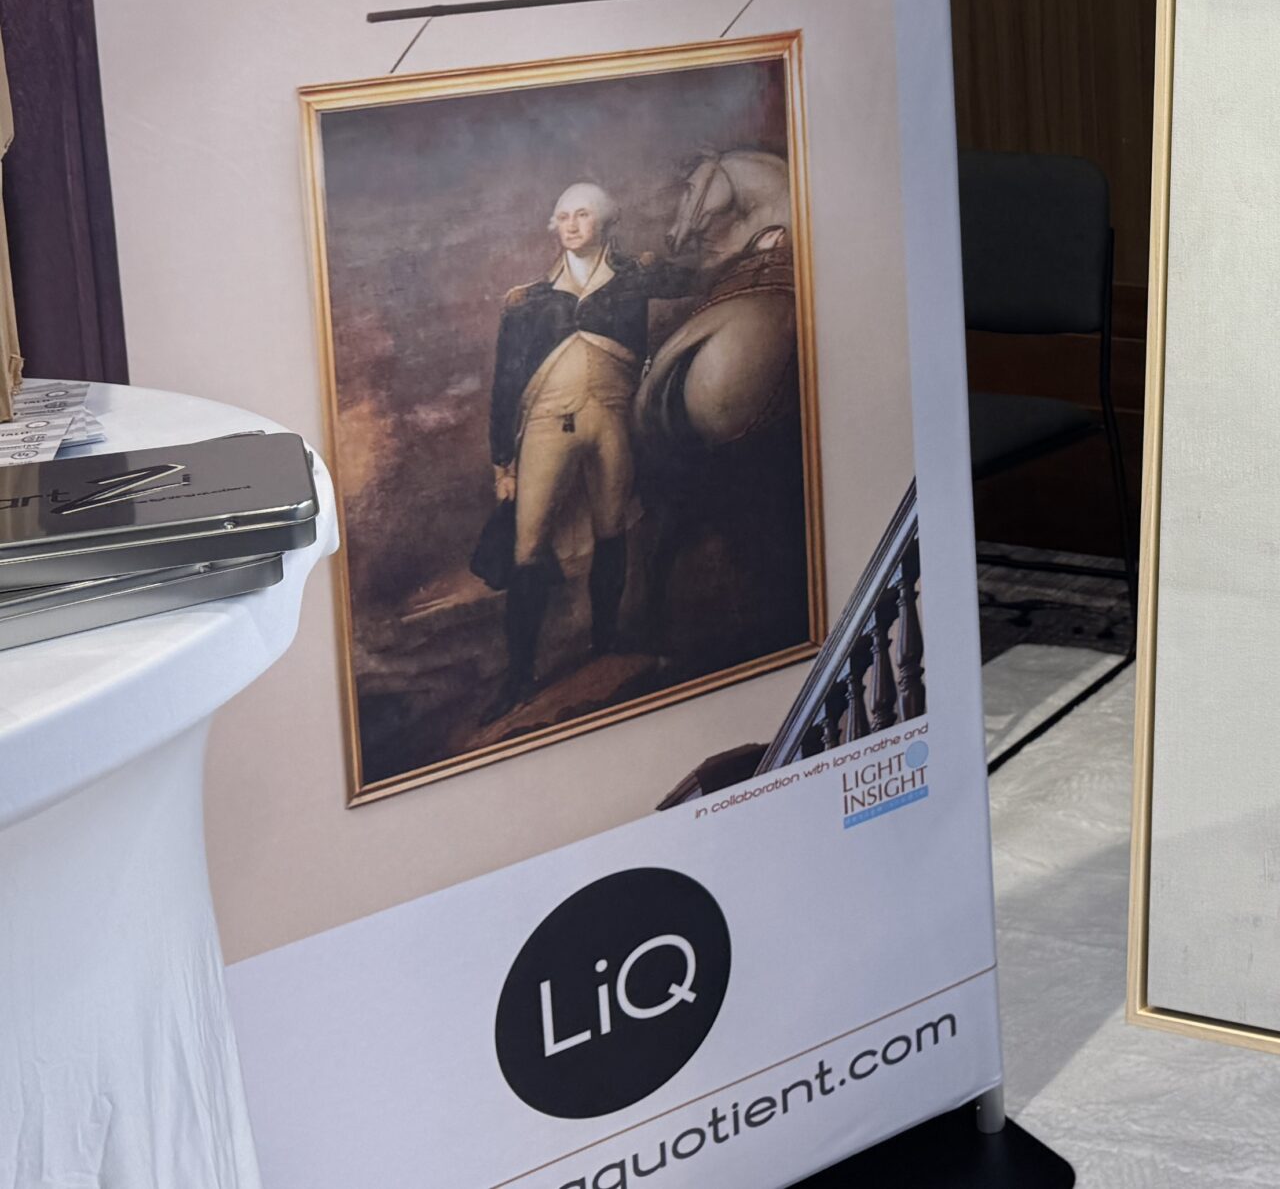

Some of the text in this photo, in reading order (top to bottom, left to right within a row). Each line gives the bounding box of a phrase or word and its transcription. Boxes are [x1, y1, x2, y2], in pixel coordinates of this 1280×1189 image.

[695, 805, 709, 819] in
[711, 773, 800, 813] collaboration
[803, 762, 830, 779] with
[863, 735, 901, 756] nathe
[904, 722, 929, 741] and
[843, 751, 905, 793] LIGHT
[843, 765, 928, 815] INSIGHT
[541, 934, 697, 1057] LiQ
